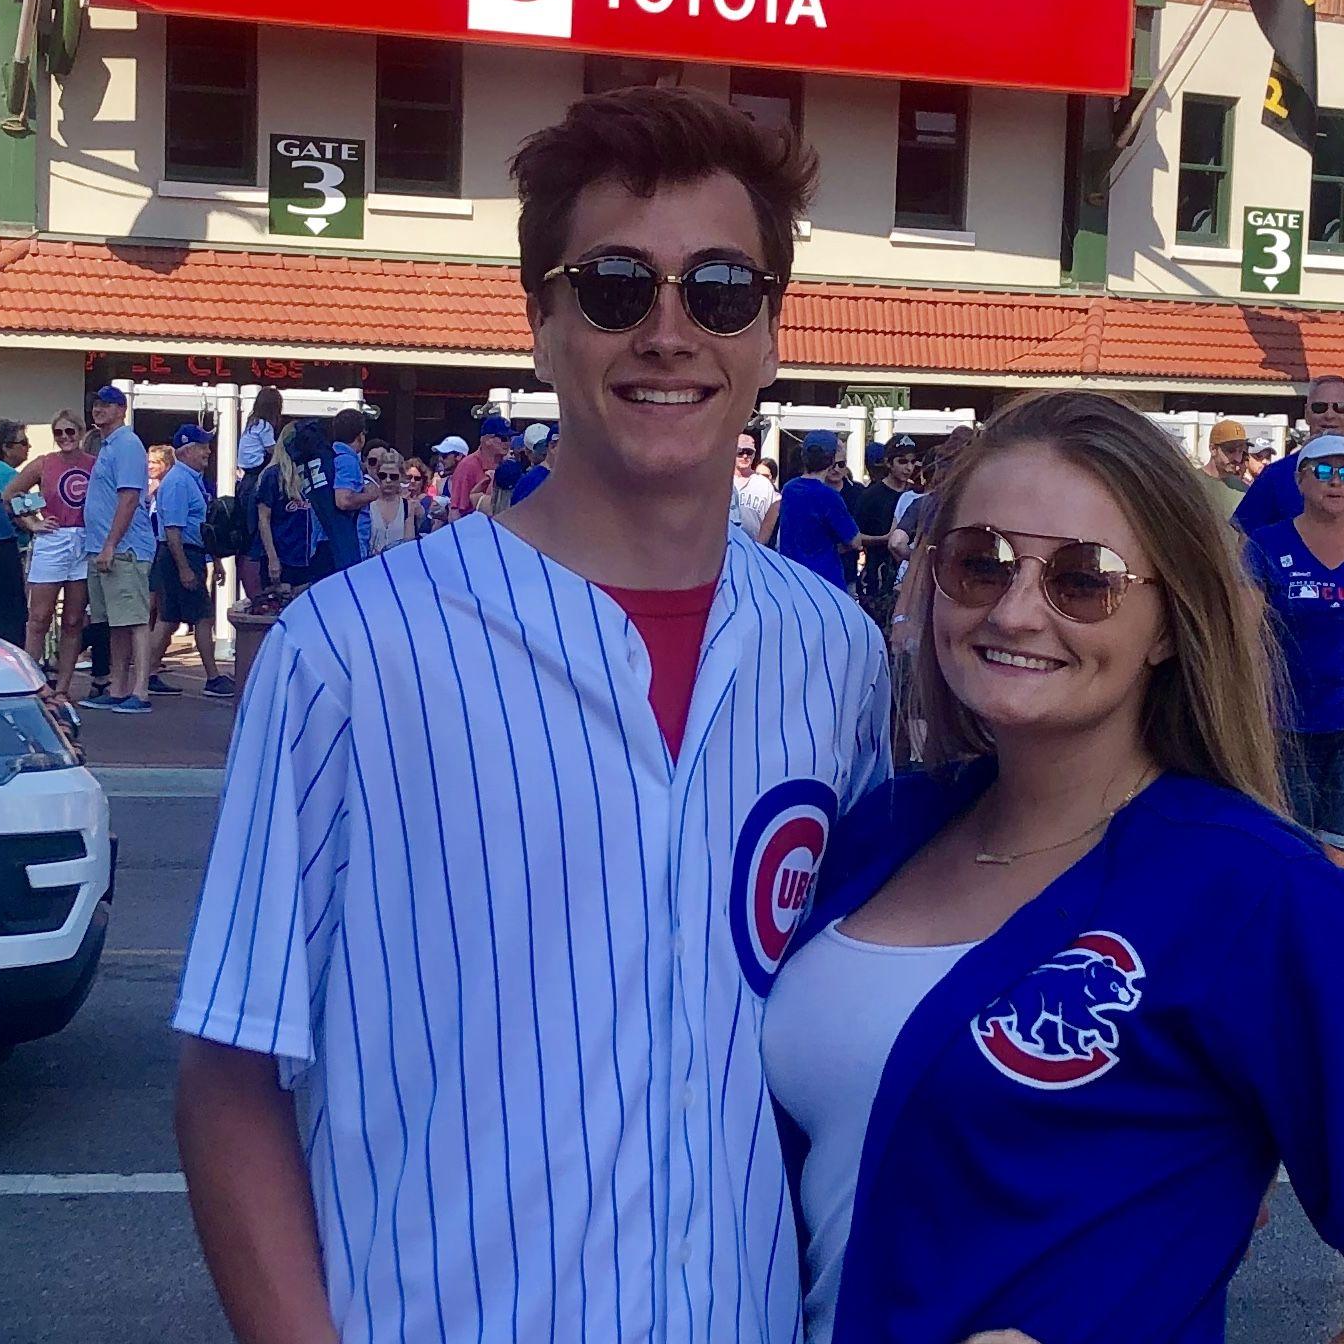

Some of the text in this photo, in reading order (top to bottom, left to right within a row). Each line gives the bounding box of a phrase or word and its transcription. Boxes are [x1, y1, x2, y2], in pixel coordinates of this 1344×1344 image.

[276, 139, 359, 161] GATE
[287, 160, 347, 216] 3
[1247, 210, 1301, 229] GATE
[1252, 227, 1291, 275] 3
